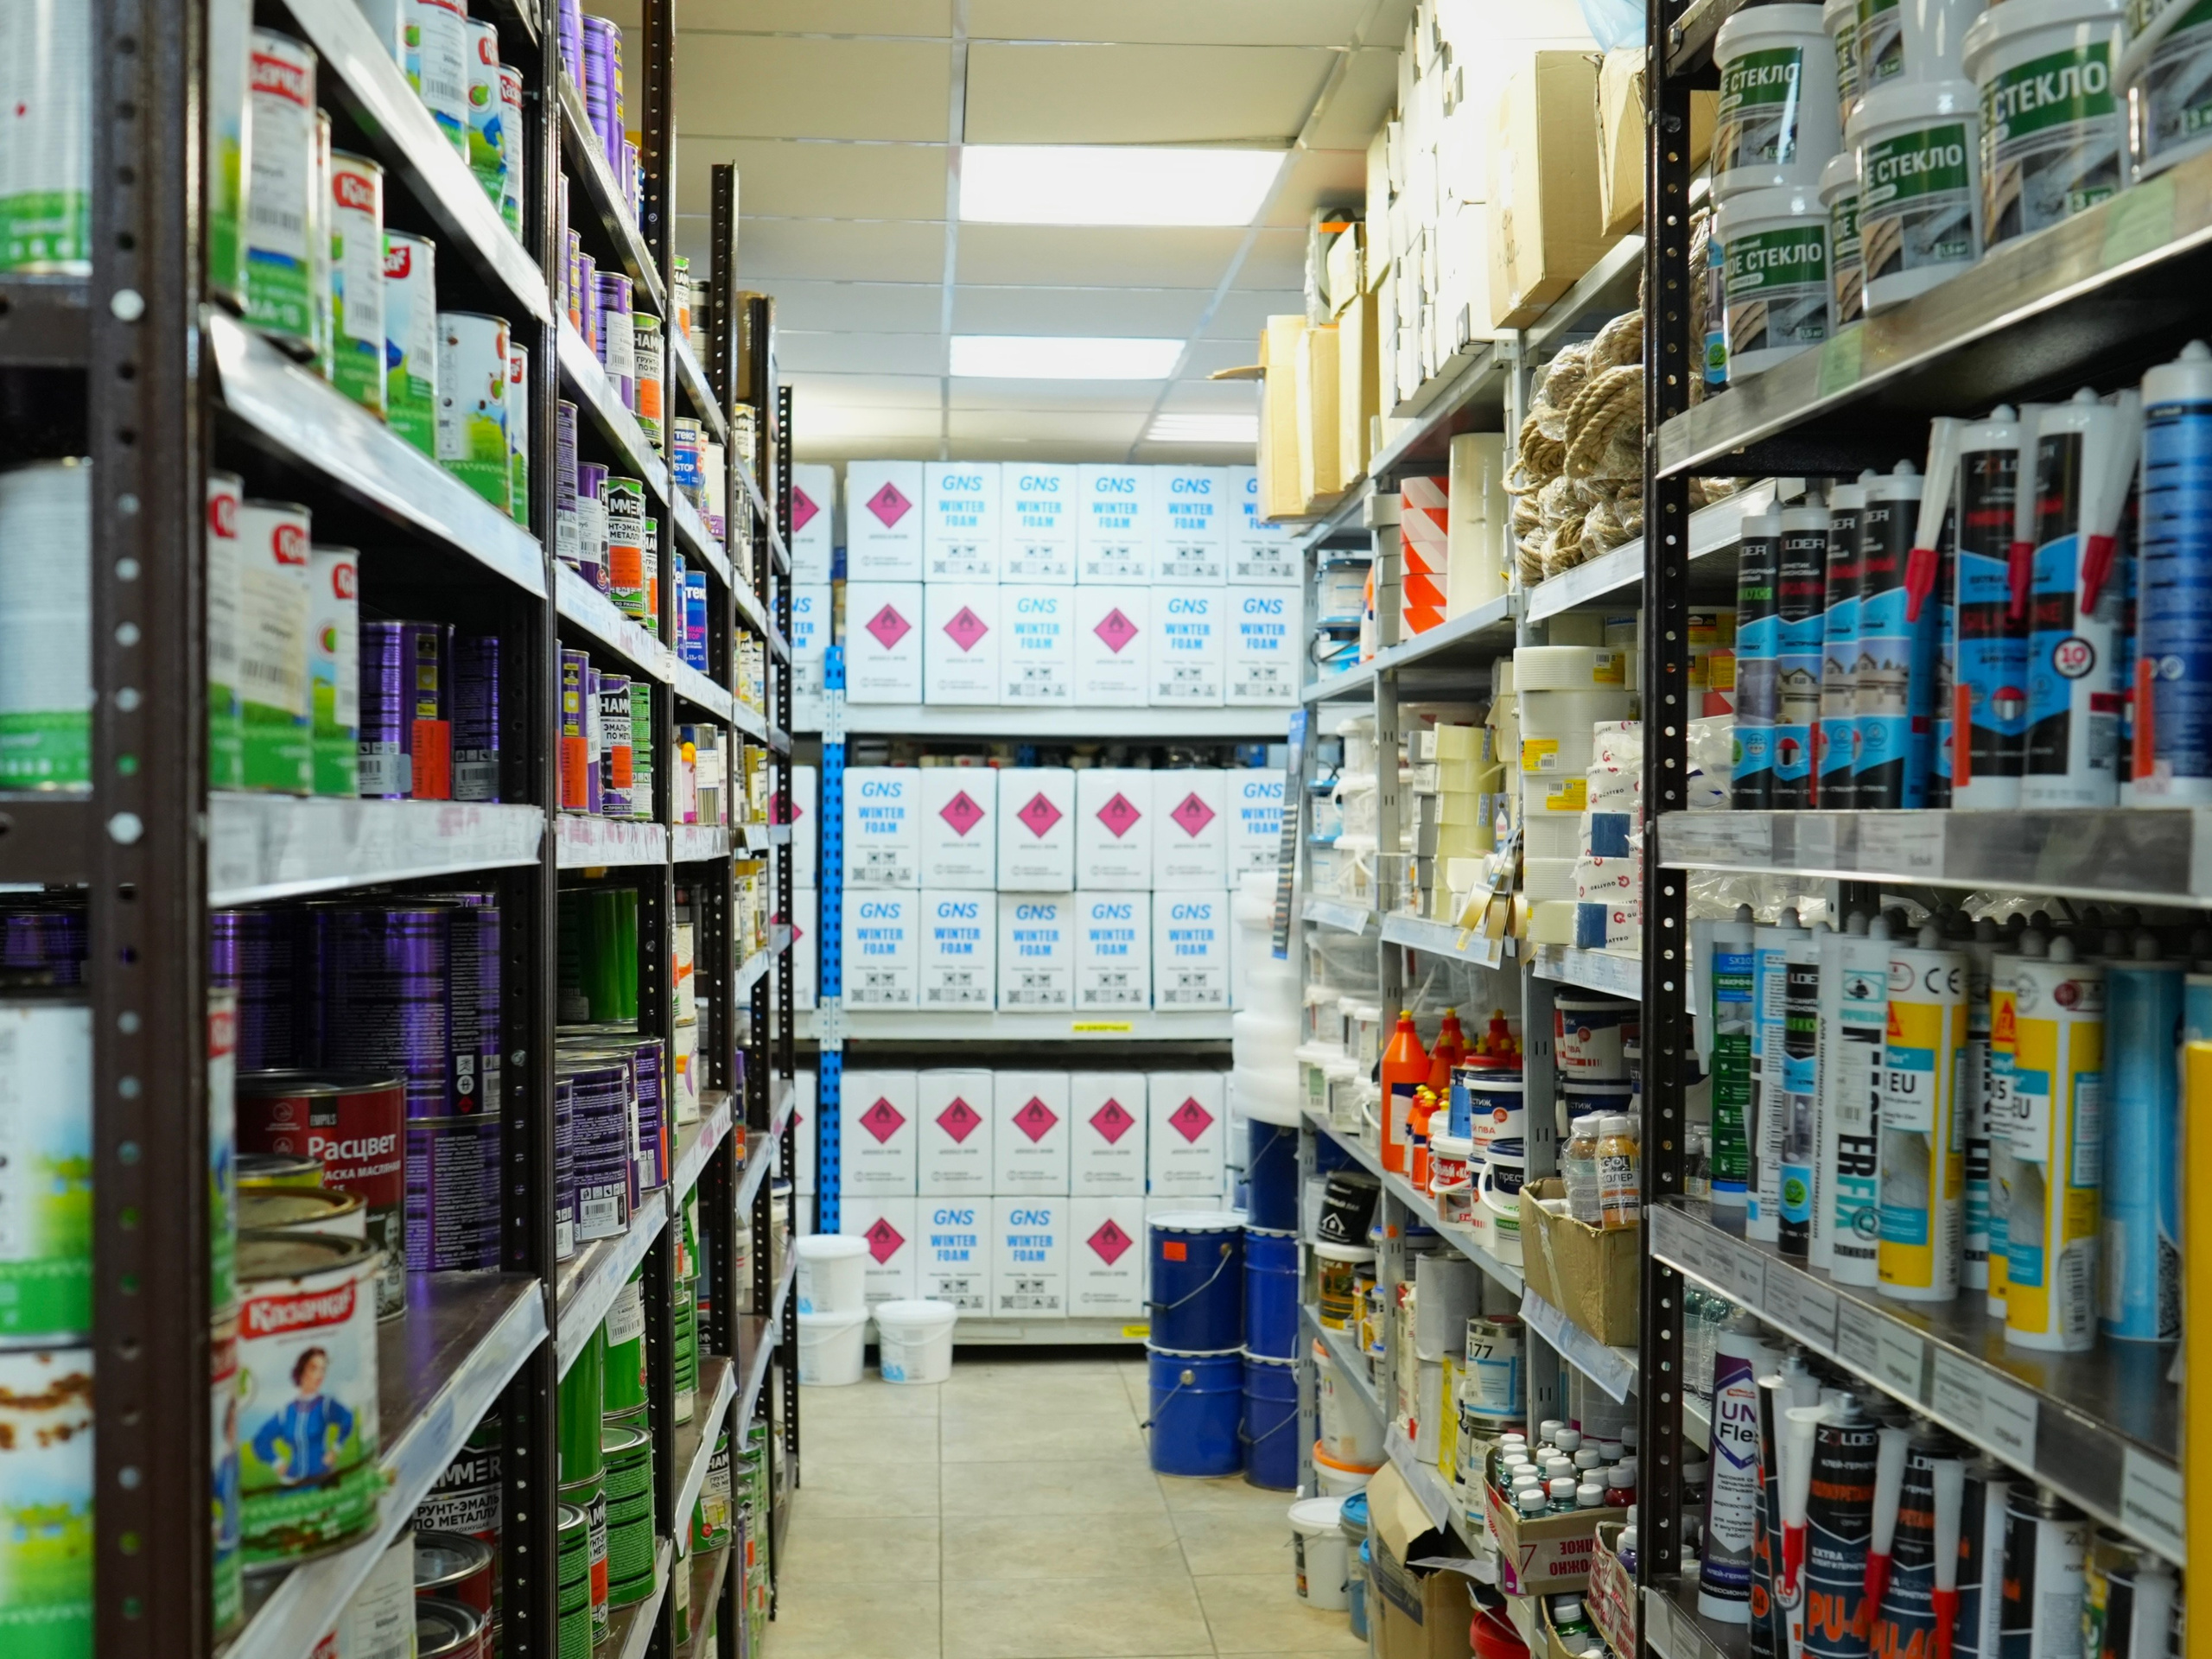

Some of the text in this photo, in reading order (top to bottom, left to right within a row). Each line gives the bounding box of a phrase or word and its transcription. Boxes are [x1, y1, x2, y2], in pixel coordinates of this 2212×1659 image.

[1731, 62, 1801, 92] СТЕКЛО
[1994, 60, 2108, 123] СТЕКЛО
[1877, 143, 1964, 184] СТЕКЛО
[1746, 243, 1822, 270] СТЕКЛО
[639, 363, 648, 372] ПО
[943, 475, 982, 491] GNS
[1020, 476, 1059, 492] GNS
[1096, 477, 1135, 493] GNS
[1171, 478, 1211, 494] GNS
[939, 501, 984, 514] WINTER
[1016, 502, 1061, 514] WINTER
[1092, 503, 1138, 515] WINTER
[1167, 503, 1214, 516] WINTER
[946, 516, 977, 527] FOAM
[1023, 518, 1054, 528] FOAM
[1099, 518, 1131, 530] FOAM
[1174, 518, 1206, 530] FOAM
[1018, 599, 1056, 614] GNS
[1167, 599, 1208, 615] GNS
[1243, 598, 1284, 614] GNS
[1014, 624, 1059, 636] WINTER
[1165, 624, 1211, 637] WINTER
[1241, 624, 1286, 637] WINTER
[1021, 639, 1052, 650] FOAM
[1171, 639, 1204, 650] FOAM
[1247, 639, 1279, 650] FOAM
[2062, 646, 2088, 664] 10
[607, 732, 618, 741] ПО
[861, 781, 901, 798] GNS
[1244, 783, 1284, 798] GNS
[1599, 788, 1624, 798] QUATTRO
[858, 807, 905, 820] WINTER
[865, 822, 898, 834] FOAM
[1248, 823, 1280, 834] FOAM
[860, 903, 900, 919] GNS
[937, 902, 979, 919] GNS
[1015, 905, 1056, 921] GNS
[1091, 904, 1132, 920] GNS
[1171, 905, 1211, 920] GNS
[857, 928, 904, 941] WINTER
[934, 927, 981, 940] WINTER
[1013, 930, 1059, 943] WINTER
[1089, 929, 1135, 942] WINTER
[1168, 929, 1215, 942] WINTER
[863, 944, 896, 956] FOAM
[940, 943, 974, 955] FOAM
[1020, 945, 1052, 957] FOAM
[1096, 944, 1128, 956] FOAM
[1175, 944, 1208, 956] FOAM
[1478, 1126, 1497, 1135] ПВА
[308, 1134, 397, 1162] Расцвет
[933, 1210, 974, 1226] GNS
[1009, 1210, 1051, 1226] GNS
[931, 1235, 977, 1248] WINTER
[1007, 1236, 1052, 1249] WINTER
[938, 1249, 969, 1262] FOAM
[1014, 1250, 1046, 1262] FOAM
[1469, 1341, 1494, 1360] 177
[438, 1508, 499, 1528] МЕТАЛЛУ
